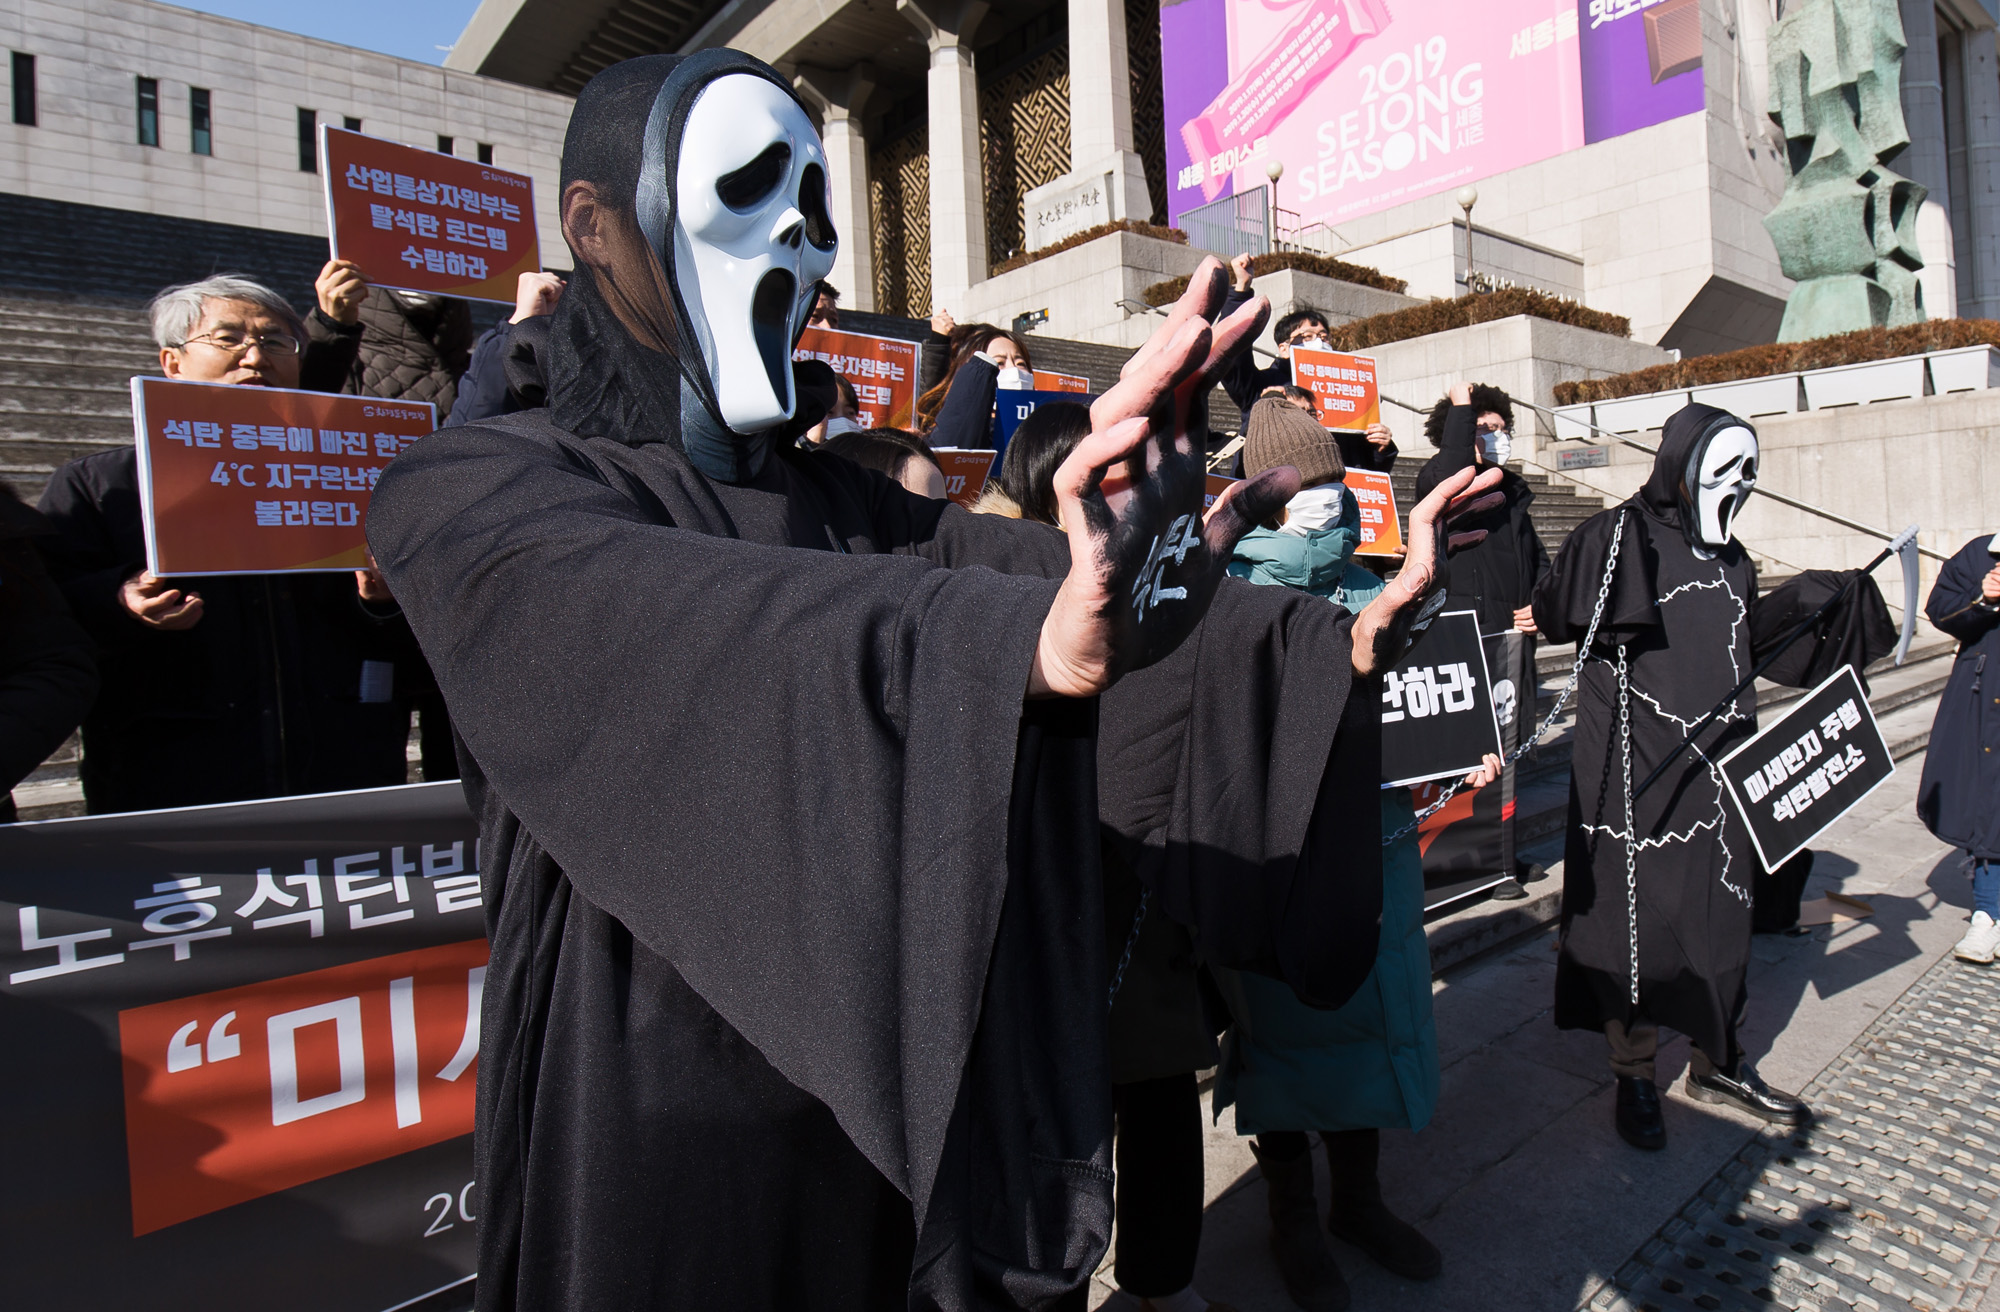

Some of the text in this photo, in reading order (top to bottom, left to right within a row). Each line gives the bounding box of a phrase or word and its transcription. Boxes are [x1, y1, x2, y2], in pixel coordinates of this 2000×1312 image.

[1508, 8, 1580, 60] 세종을
[1358, 34, 1447, 106] 2019
[1316, 62, 1484, 159] SEJONG
[1455, 102, 1484, 129] 세종
[1297, 114, 1451, 203] SEASON
[1455, 123, 1485, 150] 시즌
[1177, 135, 1269, 191] 세종 테이스트
[345, 163, 521, 222] 산업통상자원부는
[370, 203, 508, 251] 탈석탄 로드맵
[400, 245, 489, 280] 수립하라
[1298, 363, 1374, 383] 석탄 중독에 빠진 한국
[1326, 381, 1365, 397] 지구온난화
[1323, 397, 1356, 412] 불러온다
[162, 419, 224, 448] 석탄
[230, 423, 314, 453] 중독에
[318, 428, 368, 456] 빠진
[254, 500, 361, 527] 불러온다
[1743, 697, 1862, 804] 미세먼지 주범
[1772, 743, 1867, 822] 석탄발전소
